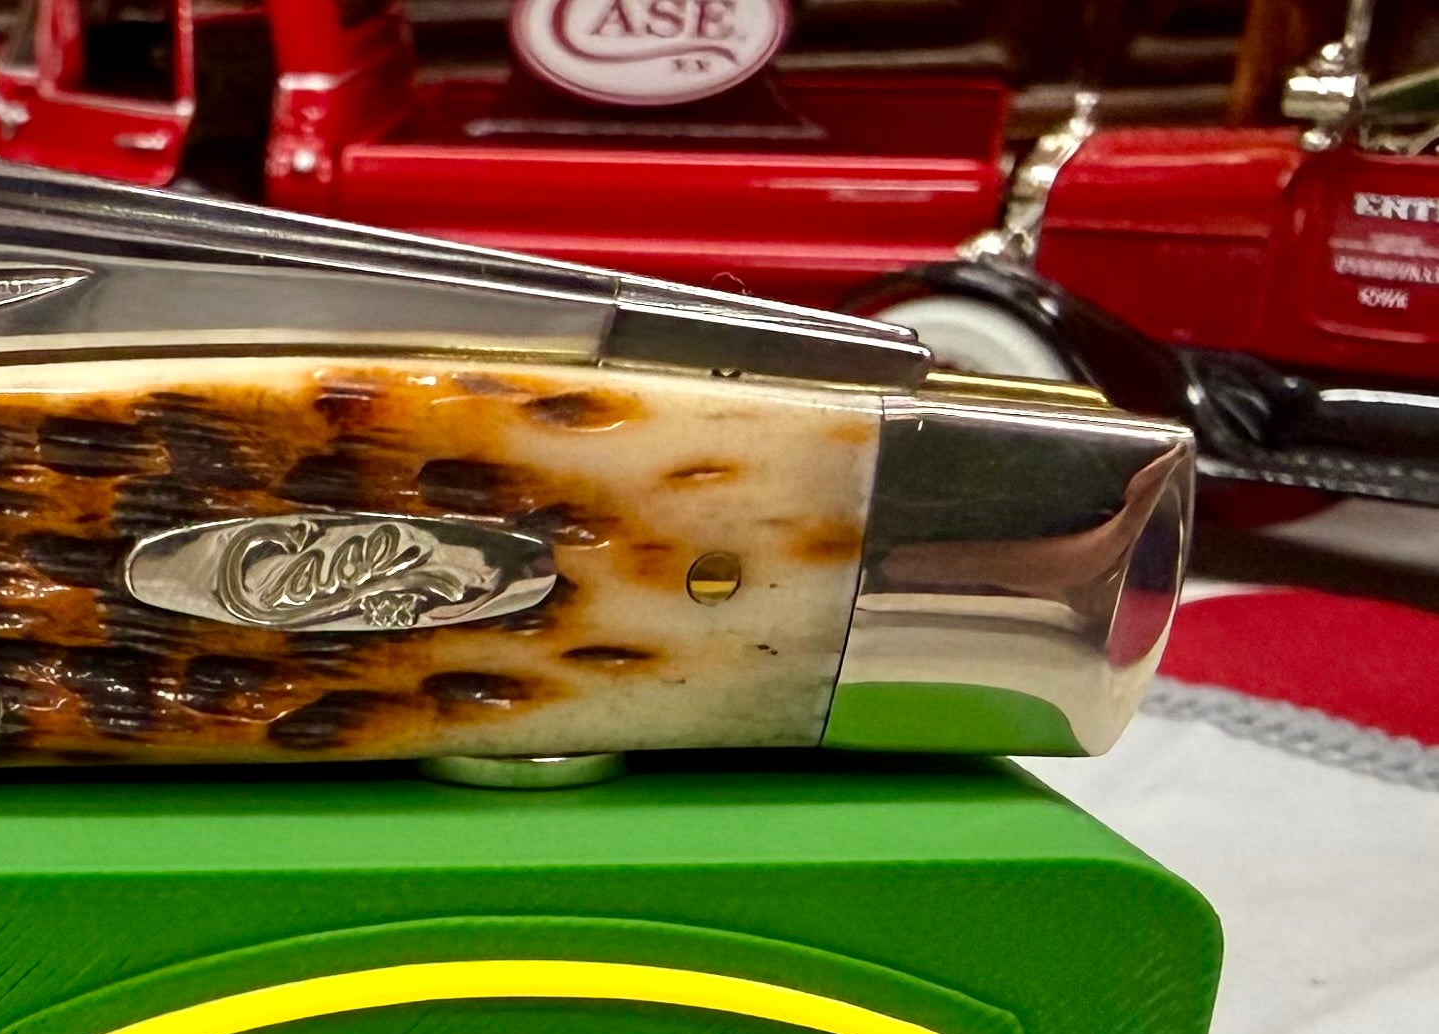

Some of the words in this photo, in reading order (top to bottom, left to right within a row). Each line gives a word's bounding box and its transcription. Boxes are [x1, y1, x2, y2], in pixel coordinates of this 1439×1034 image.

[551, 0, 738, 64] CASE
[1353, 191, 1439, 223] ENT
[216, 518, 464, 626] Case
